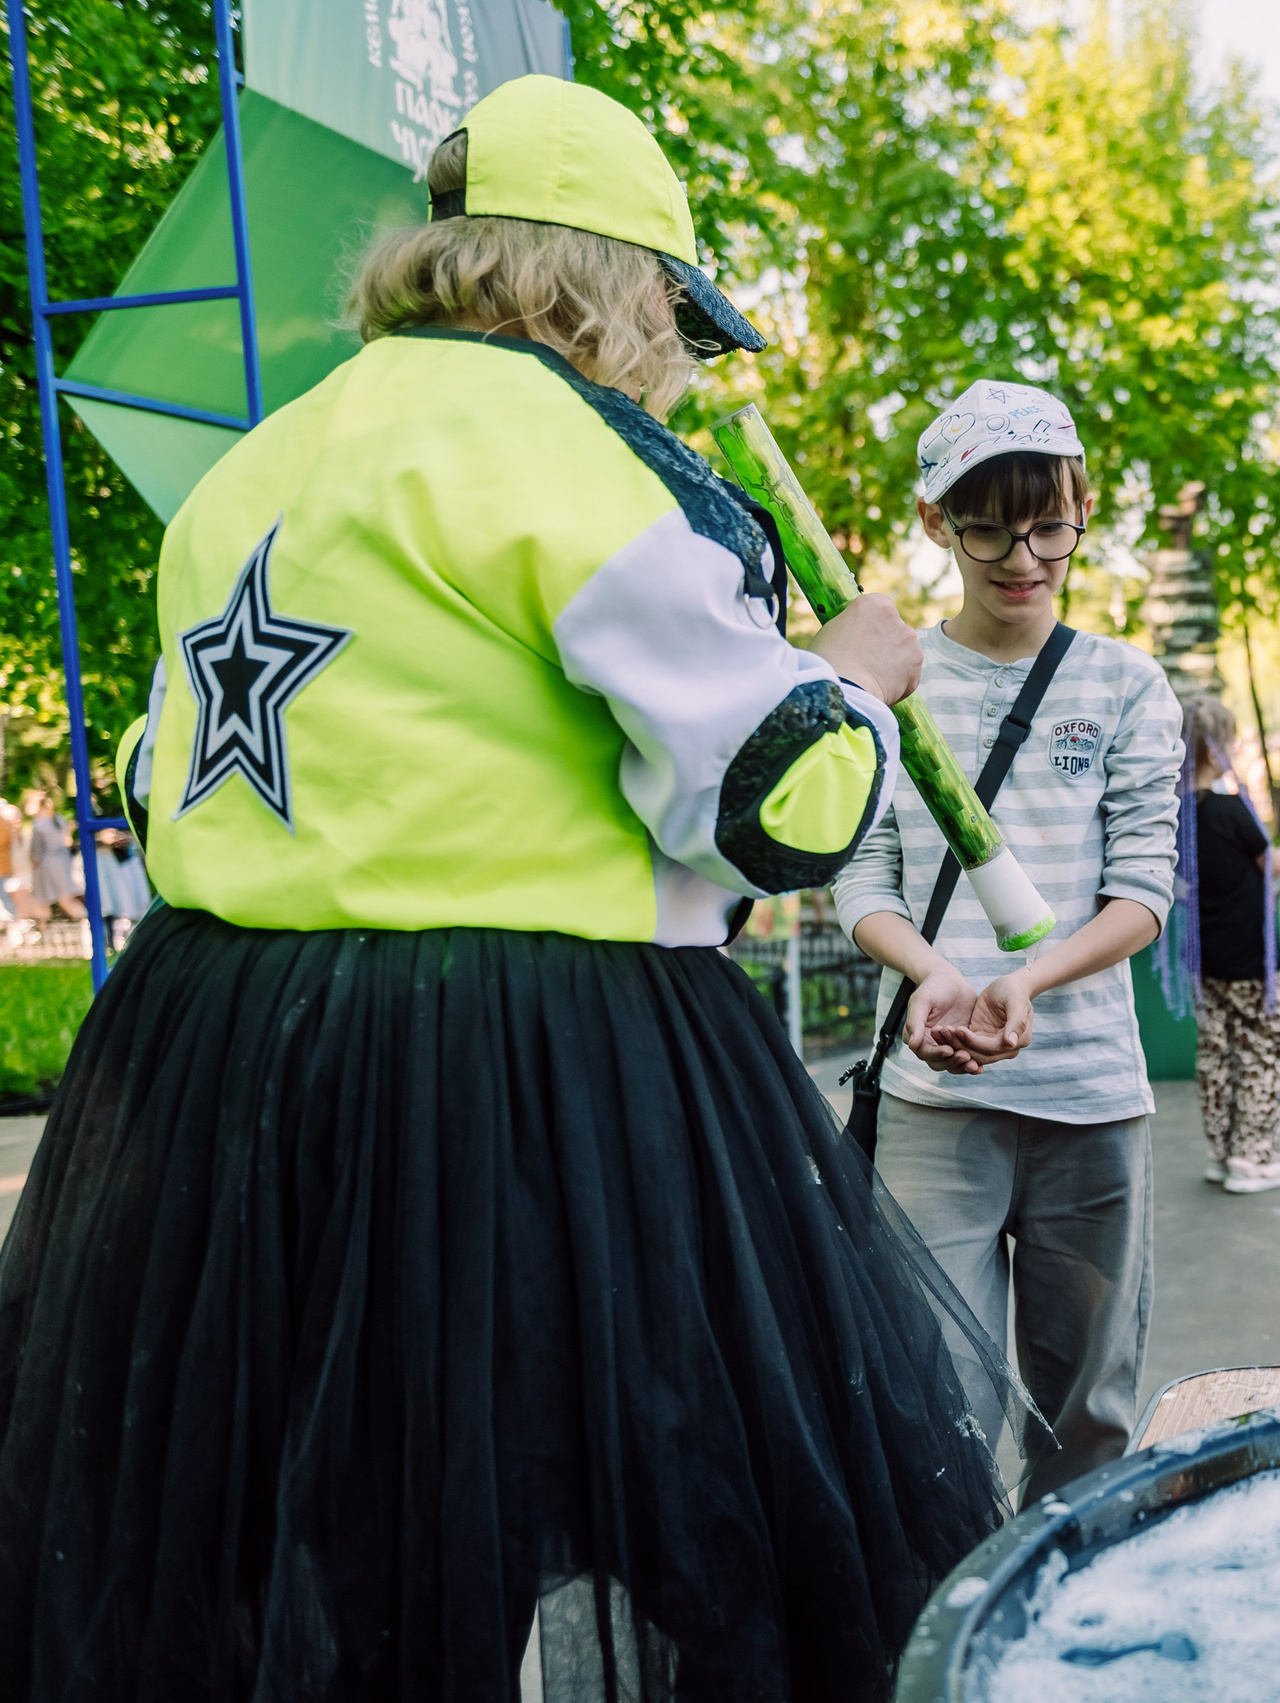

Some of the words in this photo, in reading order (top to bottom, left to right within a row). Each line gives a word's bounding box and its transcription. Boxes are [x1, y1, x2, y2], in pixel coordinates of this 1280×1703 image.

[1009, 406, 1045, 419] PEACE
[1055, 722, 1098, 738] OXFORD
[1054, 756, 1089, 775] LIONS
